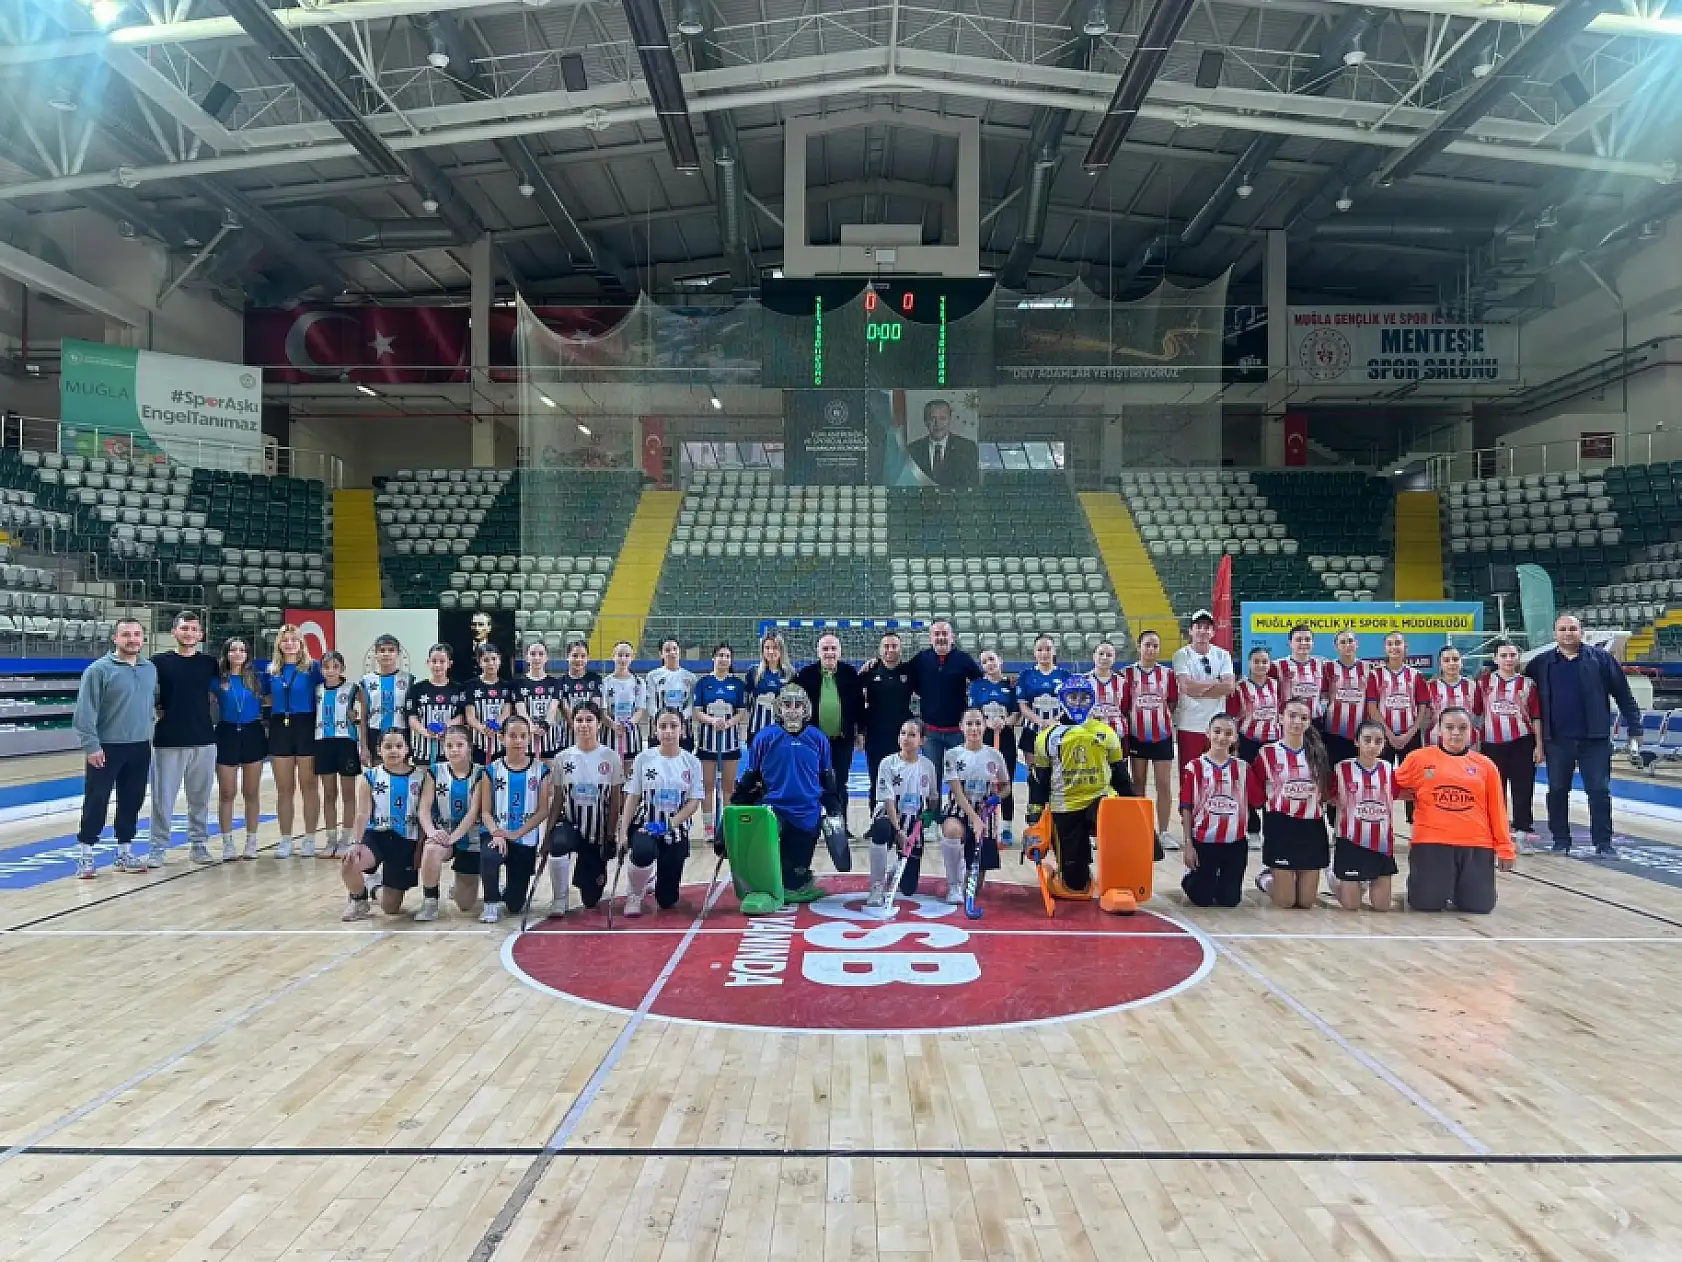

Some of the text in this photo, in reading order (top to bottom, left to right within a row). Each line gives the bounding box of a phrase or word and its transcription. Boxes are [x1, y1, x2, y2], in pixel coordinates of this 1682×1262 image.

[903, 293, 913, 309] 0
[1381, 328, 1484, 359] MENTEŞE
[1367, 358, 1499, 380] SPOR SALONU
[65, 379, 129, 400] MUĞLA
[141, 405, 258, 431] EngelTanımaz
[1256, 615, 1292, 628] MUĞLA
[1344, 618, 1356, 628] VE
[1359, 618, 1388, 628] SPOR
[1402, 614, 1468, 628] MÜDÜRLÜĞÜ
